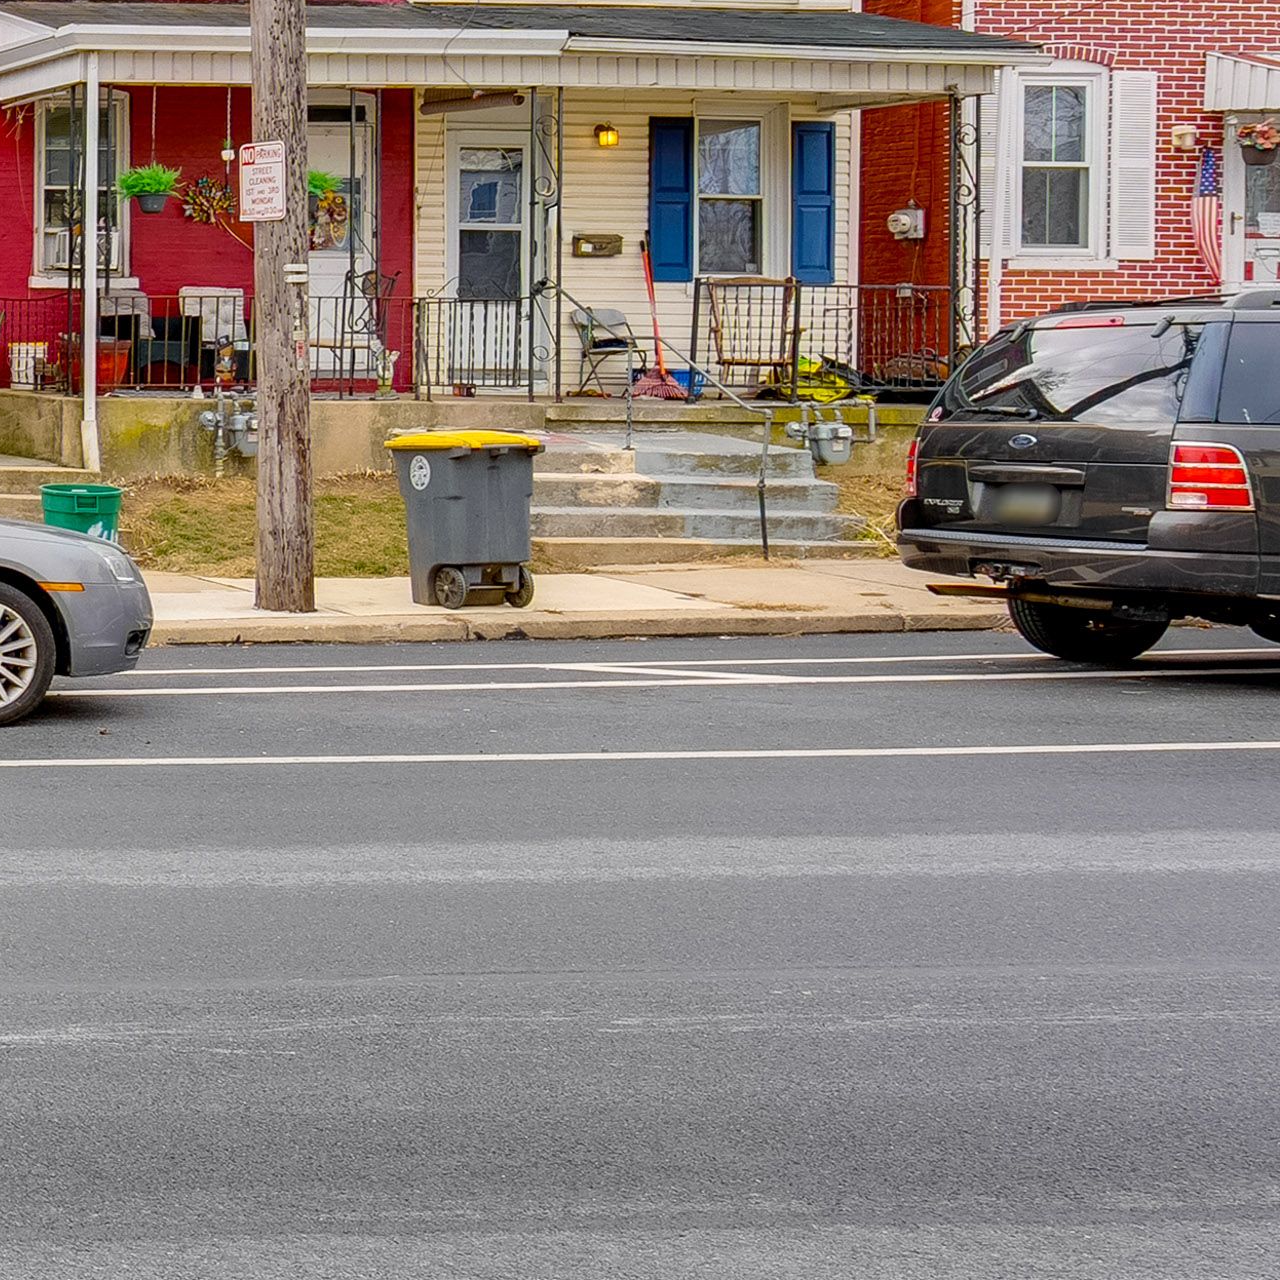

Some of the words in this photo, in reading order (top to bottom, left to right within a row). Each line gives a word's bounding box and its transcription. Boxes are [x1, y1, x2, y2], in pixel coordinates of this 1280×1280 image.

[242, 148, 254, 164] NO
[256, 148, 281, 159] PARKING
[252, 166, 272, 175] STREET
[249, 176, 276, 186] CLEANING
[251, 197, 273, 205] MONDAY
